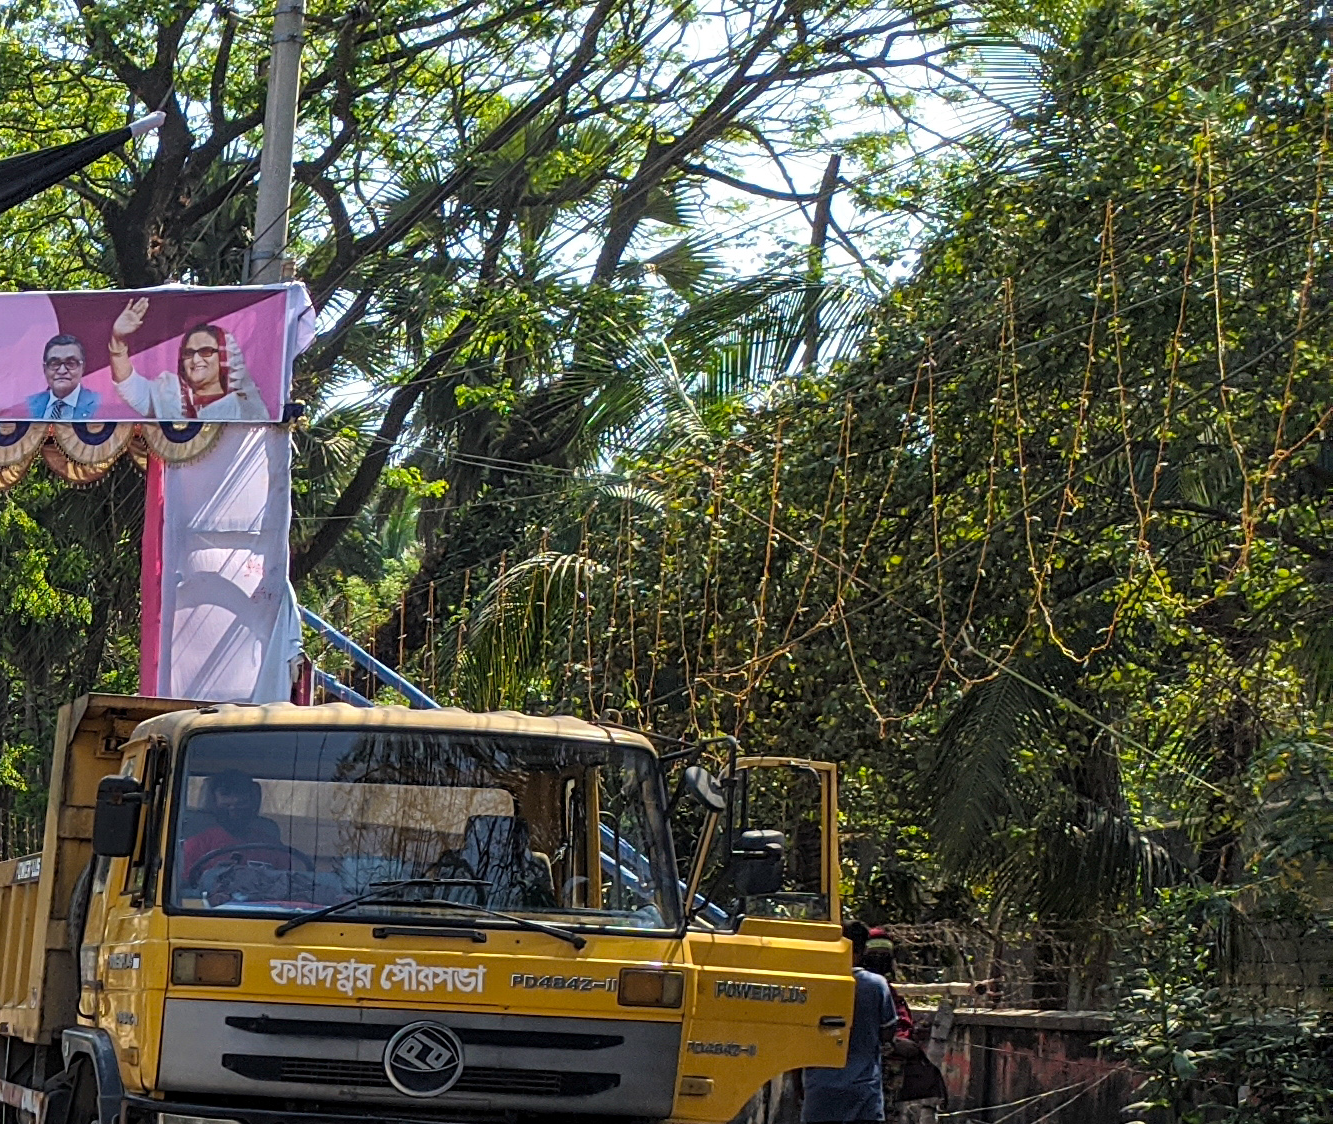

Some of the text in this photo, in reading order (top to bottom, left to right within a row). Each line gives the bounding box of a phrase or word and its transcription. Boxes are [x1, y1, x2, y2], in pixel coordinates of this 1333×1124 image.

[269, 952, 487, 996] ফরিদপুর পৌরসভা
[715, 980, 808, 1005] POWERPLUS
